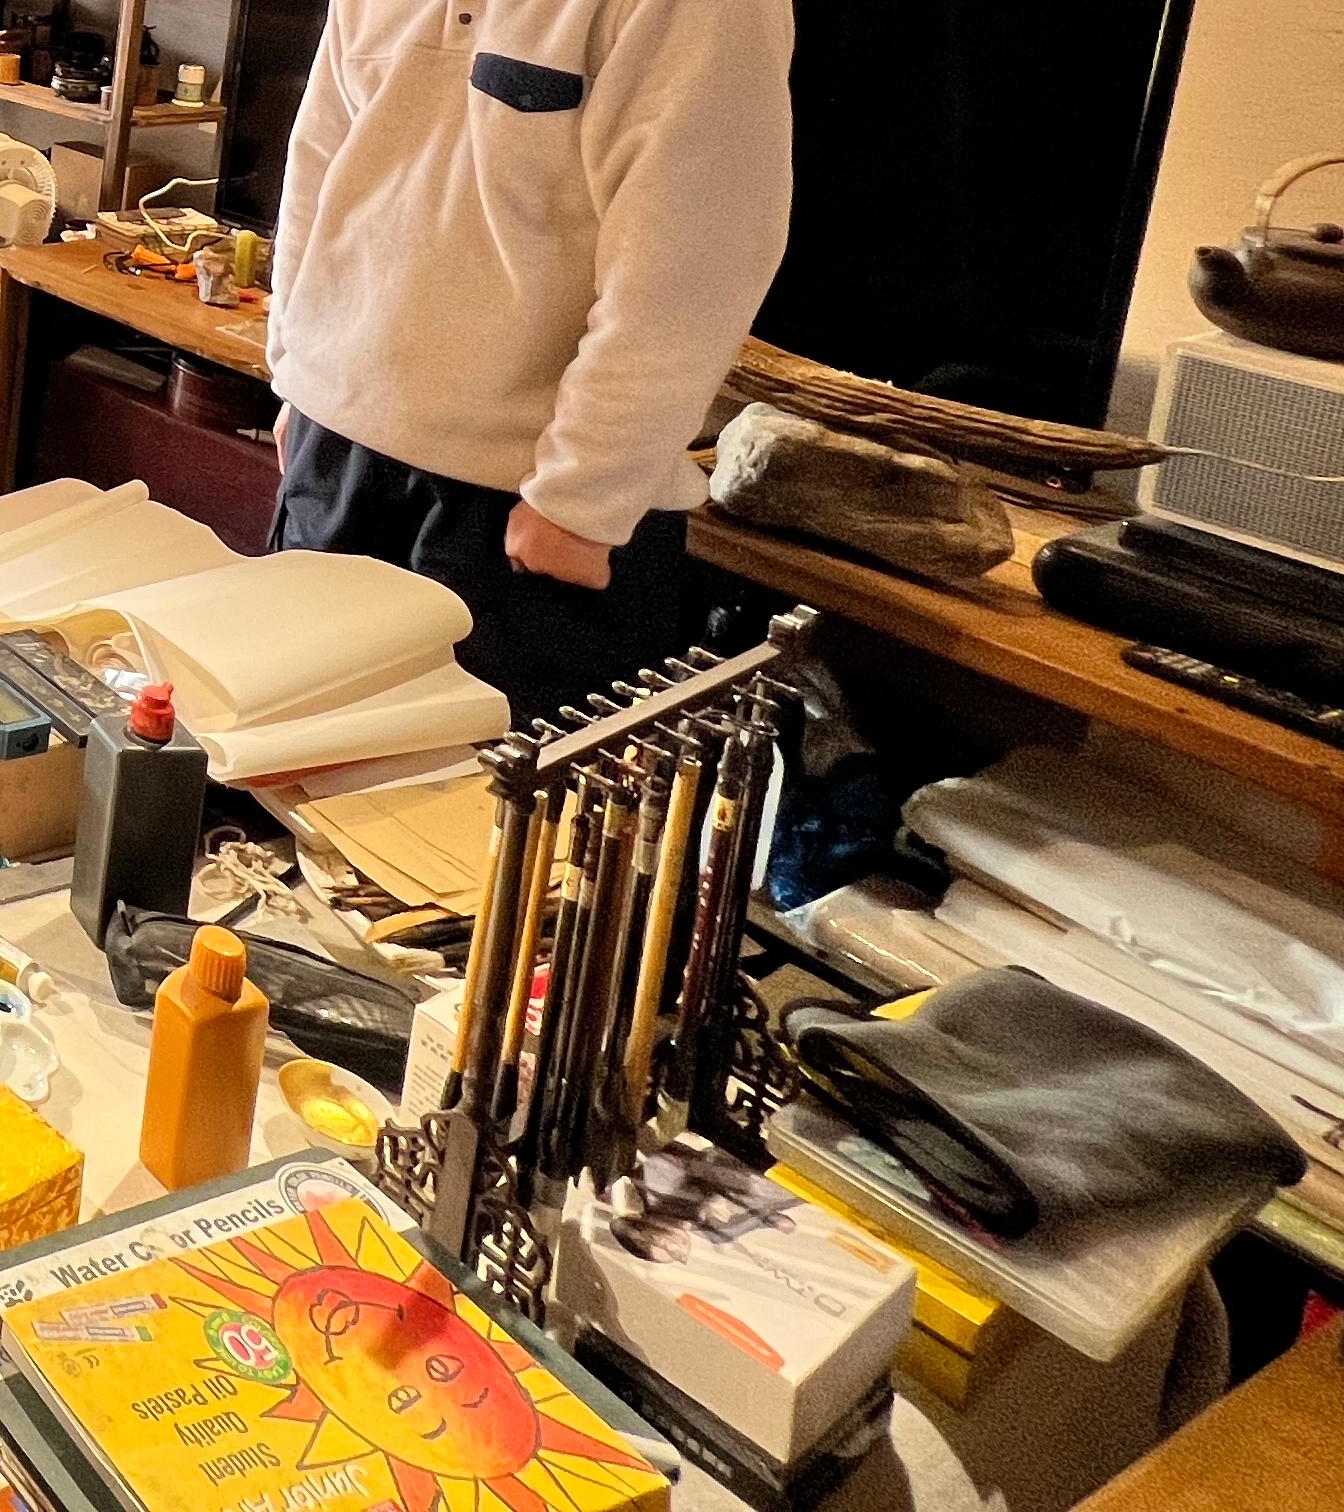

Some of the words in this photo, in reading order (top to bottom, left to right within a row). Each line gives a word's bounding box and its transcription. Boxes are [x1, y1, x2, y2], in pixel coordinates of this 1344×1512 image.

[49, 1251, 130, 1289] Water
[193, 1198, 285, 1240] Pencils
[220, 1325, 273, 1364] 50
[131, 1384, 208, 1421] Pastels
[202, 1374, 238, 1400] Oil
[174, 1411, 249, 1448] Quality
[198, 1443, 281, 1486] Student
[279, 1464, 369, 1511] Junior
